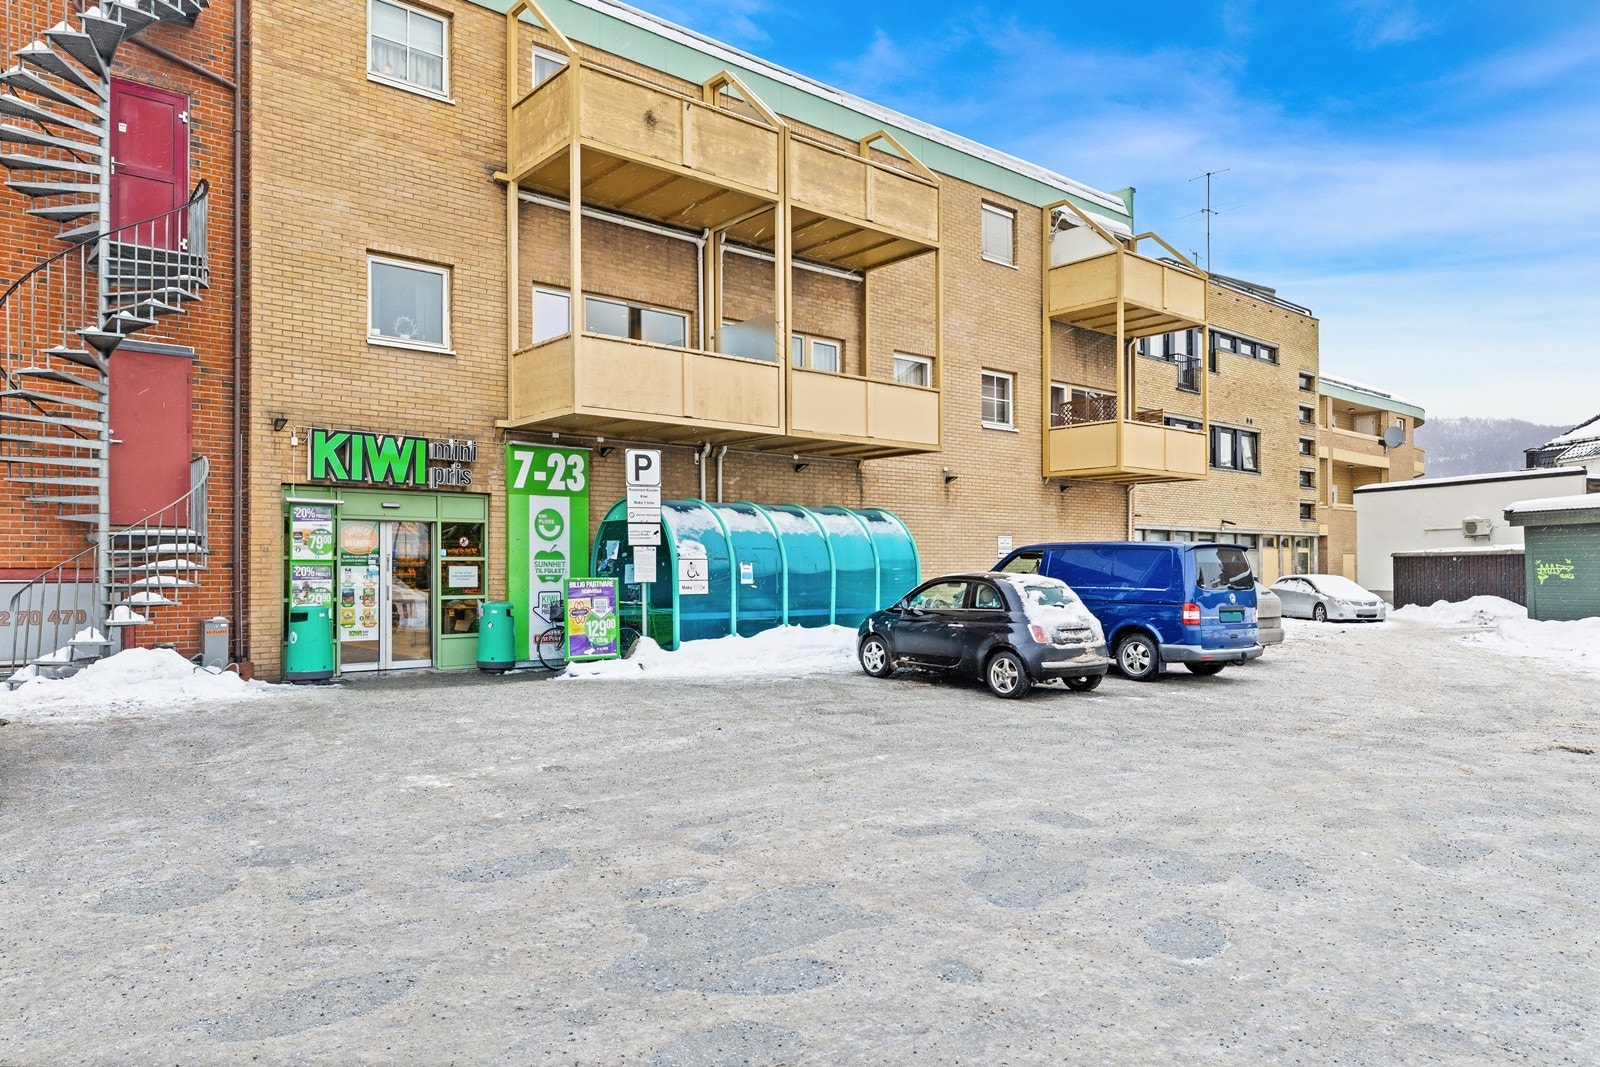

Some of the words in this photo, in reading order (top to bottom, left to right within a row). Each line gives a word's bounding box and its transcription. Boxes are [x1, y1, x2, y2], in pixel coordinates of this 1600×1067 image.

[311, 429, 429, 486] KIWI
[433, 439, 478, 463] mini
[433, 463, 473, 488] pris
[513, 451, 586, 492] 7-23
[634, 454, 653, 482] P
[293, 507, 315, 519] -20%
[293, 566, 315, 577] -20%
[534, 560, 566, 568] SUNNHET
[541, 595, 559, 604] KIWI
[17, 610, 42, 626] 70
[47, 609, 87, 626] 470
